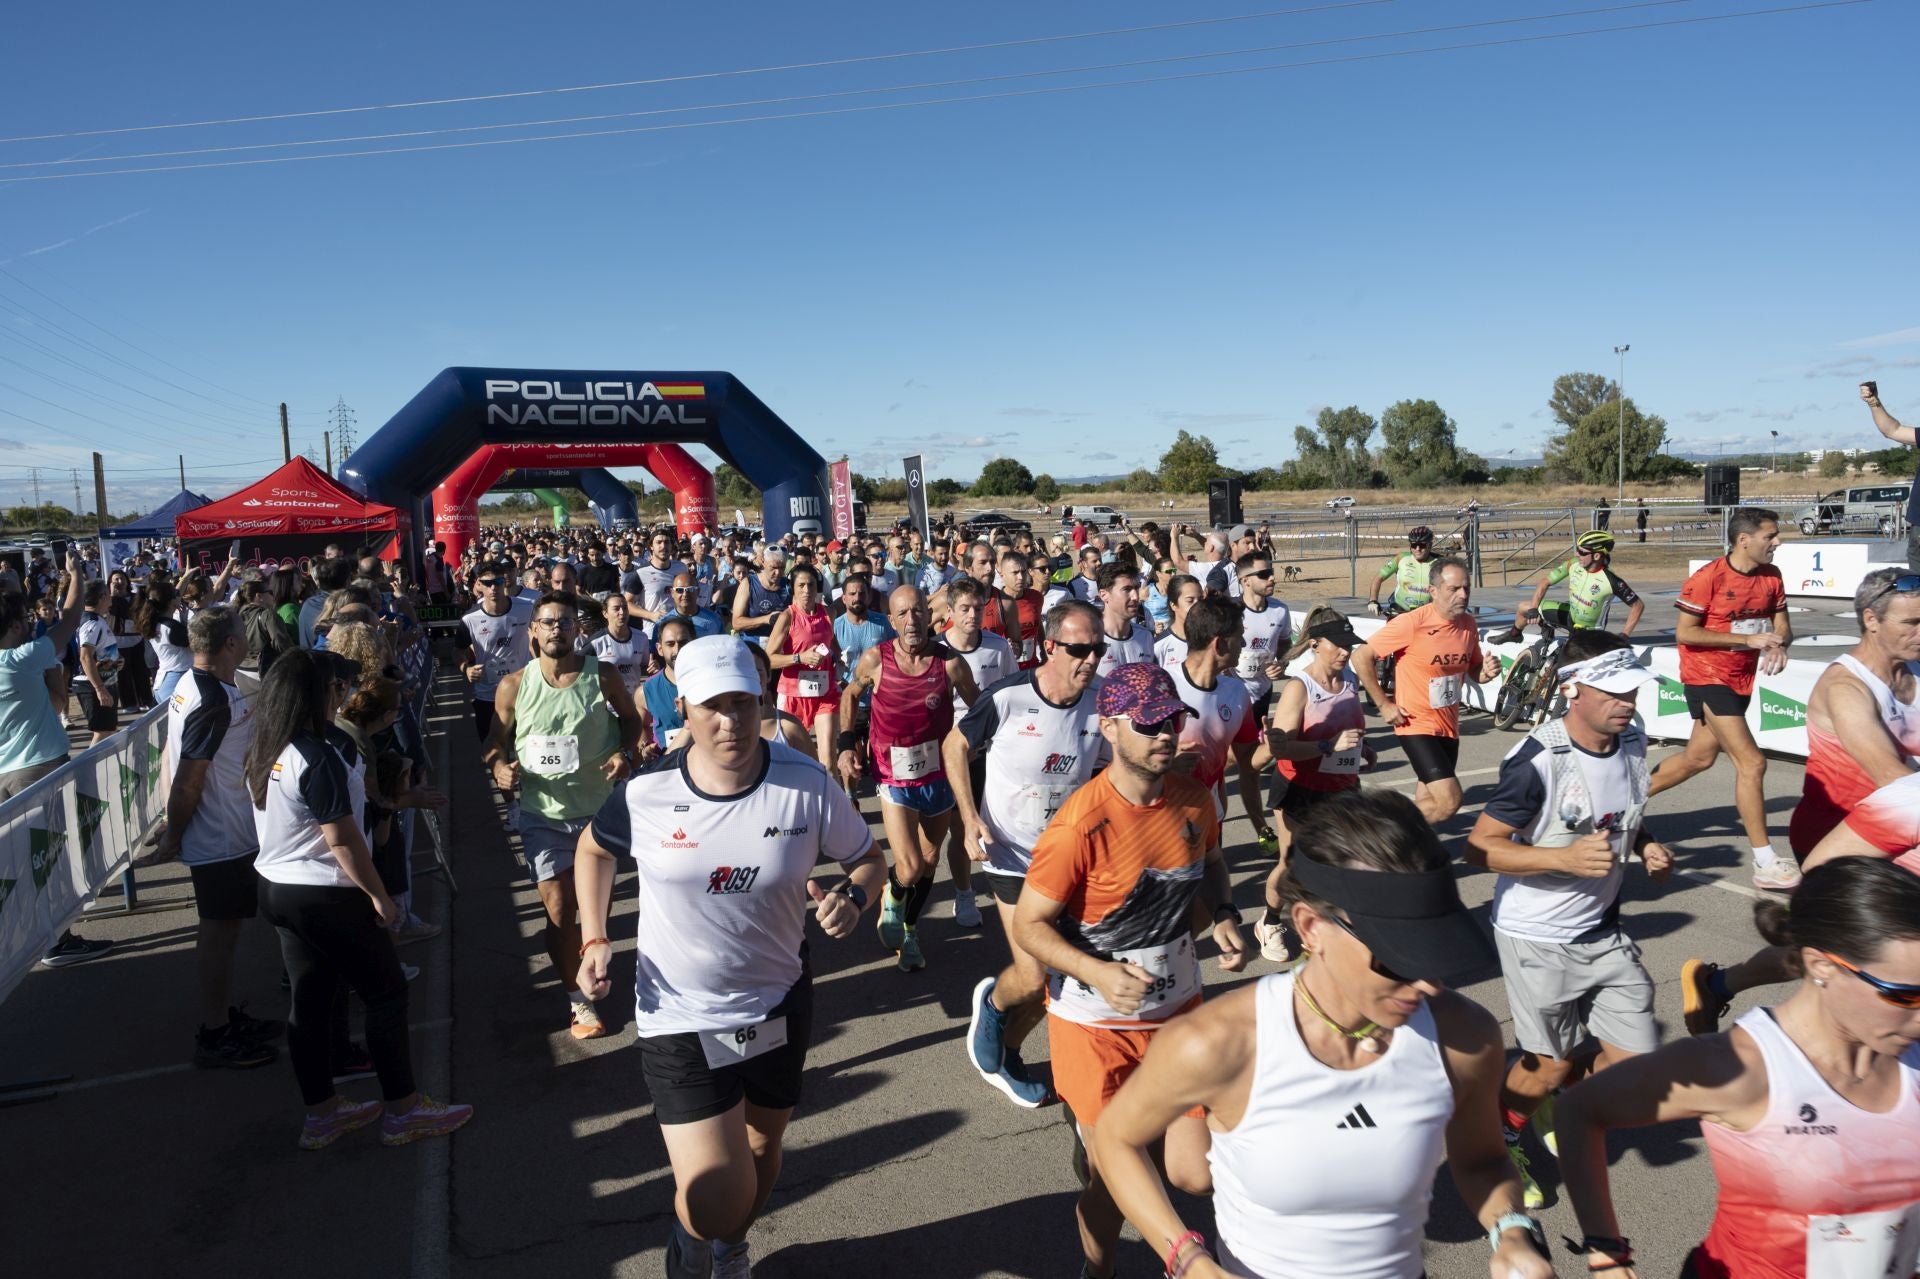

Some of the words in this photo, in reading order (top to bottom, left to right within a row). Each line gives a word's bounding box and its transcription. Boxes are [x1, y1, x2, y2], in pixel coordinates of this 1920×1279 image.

[488, 404, 706, 425] NACIONAL
[271, 488, 318, 498] Sports
[264, 499, 341, 509] Santander
[790, 497, 821, 518] RUTA
[189, 522, 219, 533] Sports
[236, 519, 282, 529] Santander
[296, 518, 326, 528] Sports
[343, 517, 386, 525] Santander
[1812, 551, 1824, 571] 1
[1772, 706, 1793, 716] Corte
[541, 755, 561, 765] 265
[908, 760, 926, 772] 277
[660, 841, 700, 849] Santander
[783, 825, 808, 837] mupol
[735, 1025, 758, 1044] 66
